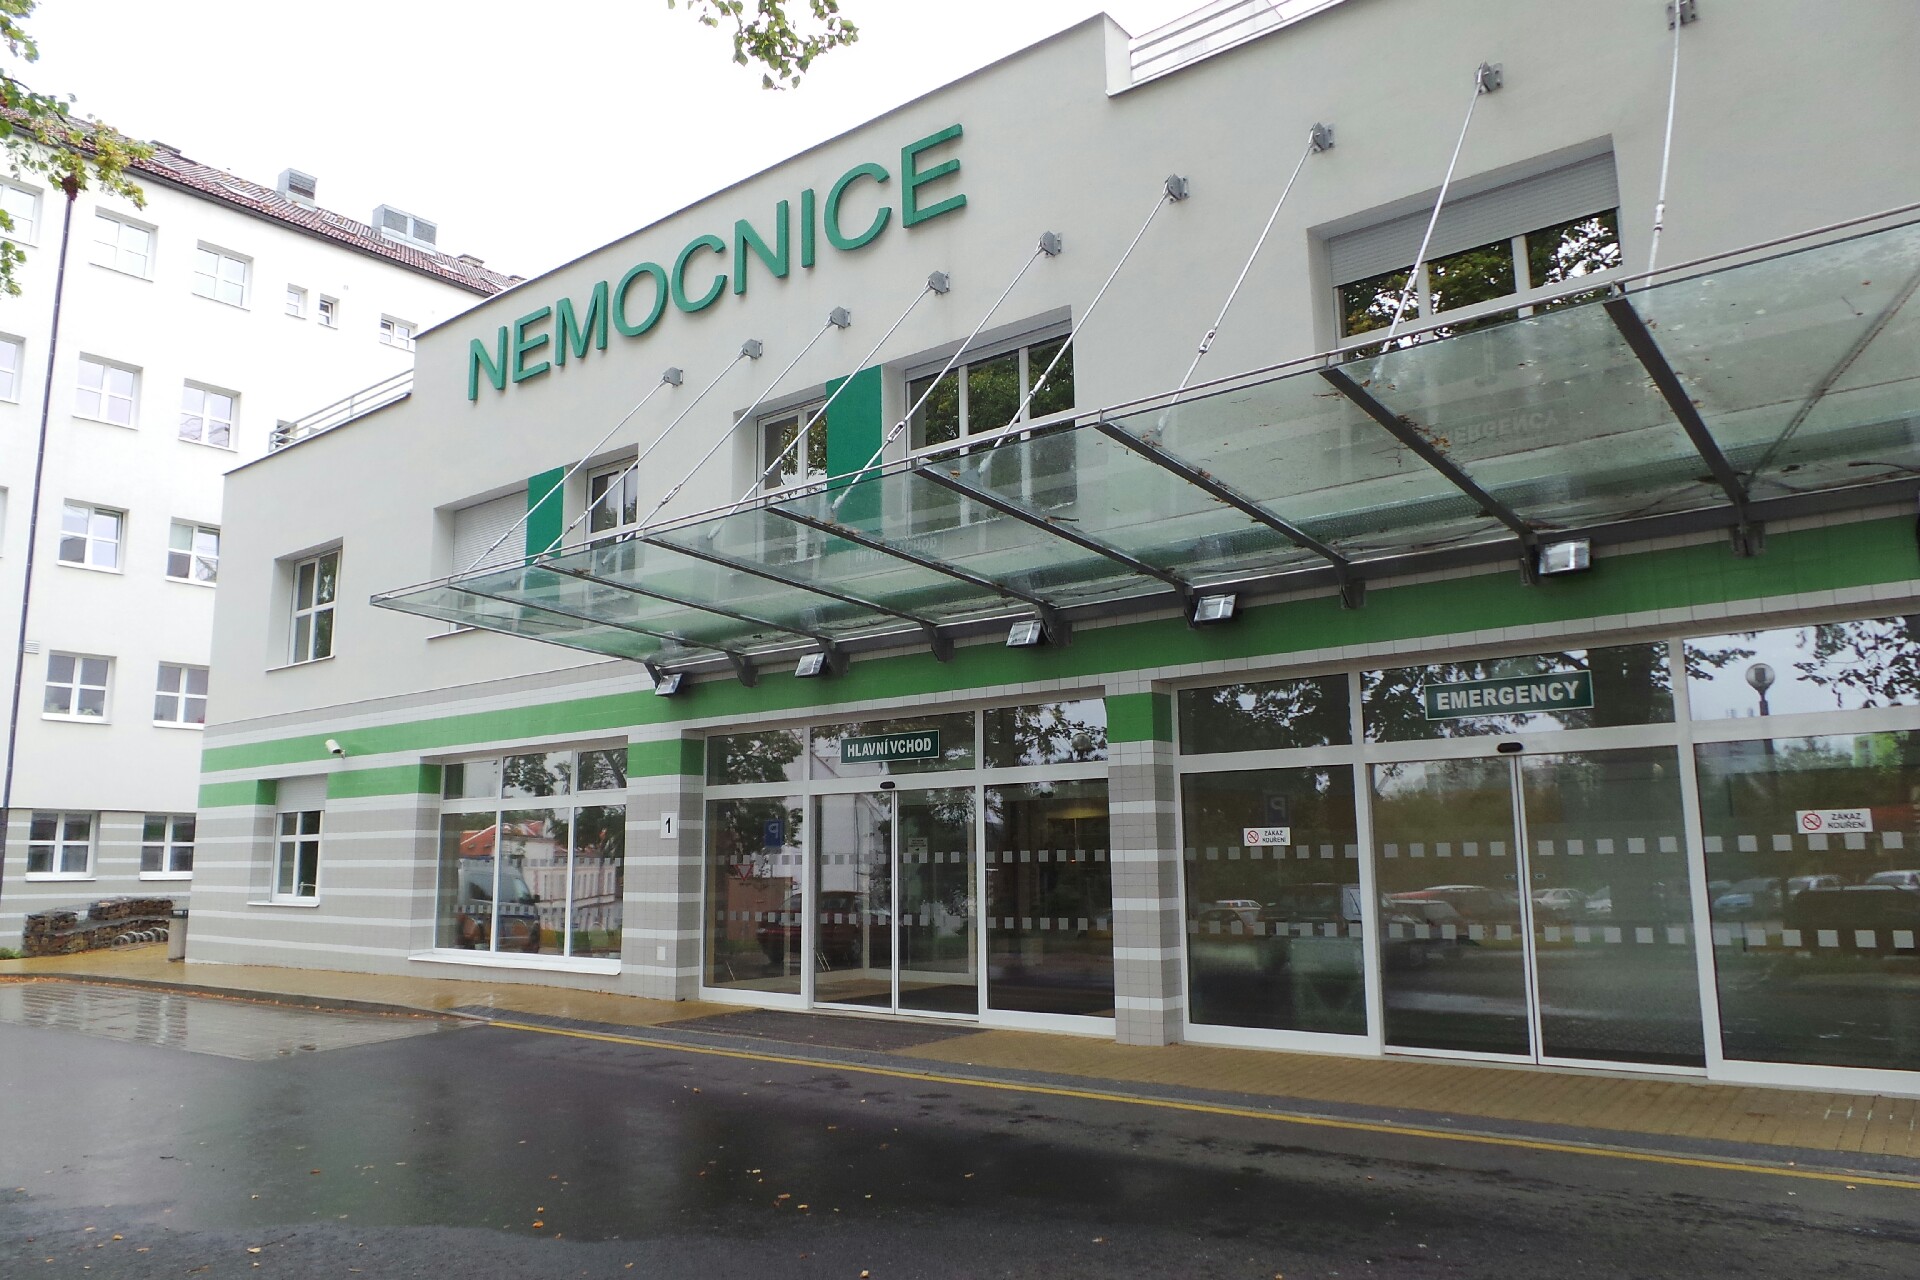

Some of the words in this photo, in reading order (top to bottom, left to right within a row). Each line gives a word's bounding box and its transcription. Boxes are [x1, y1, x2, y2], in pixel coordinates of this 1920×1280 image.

[468, 123, 967, 401] NEMOCNICE
[1436, 680, 1580, 711] EMERGENCY
[847, 738, 888, 758] HLAVNÍ
[889, 737, 932, 755] VCHOD
[665, 817, 671, 834] 1
